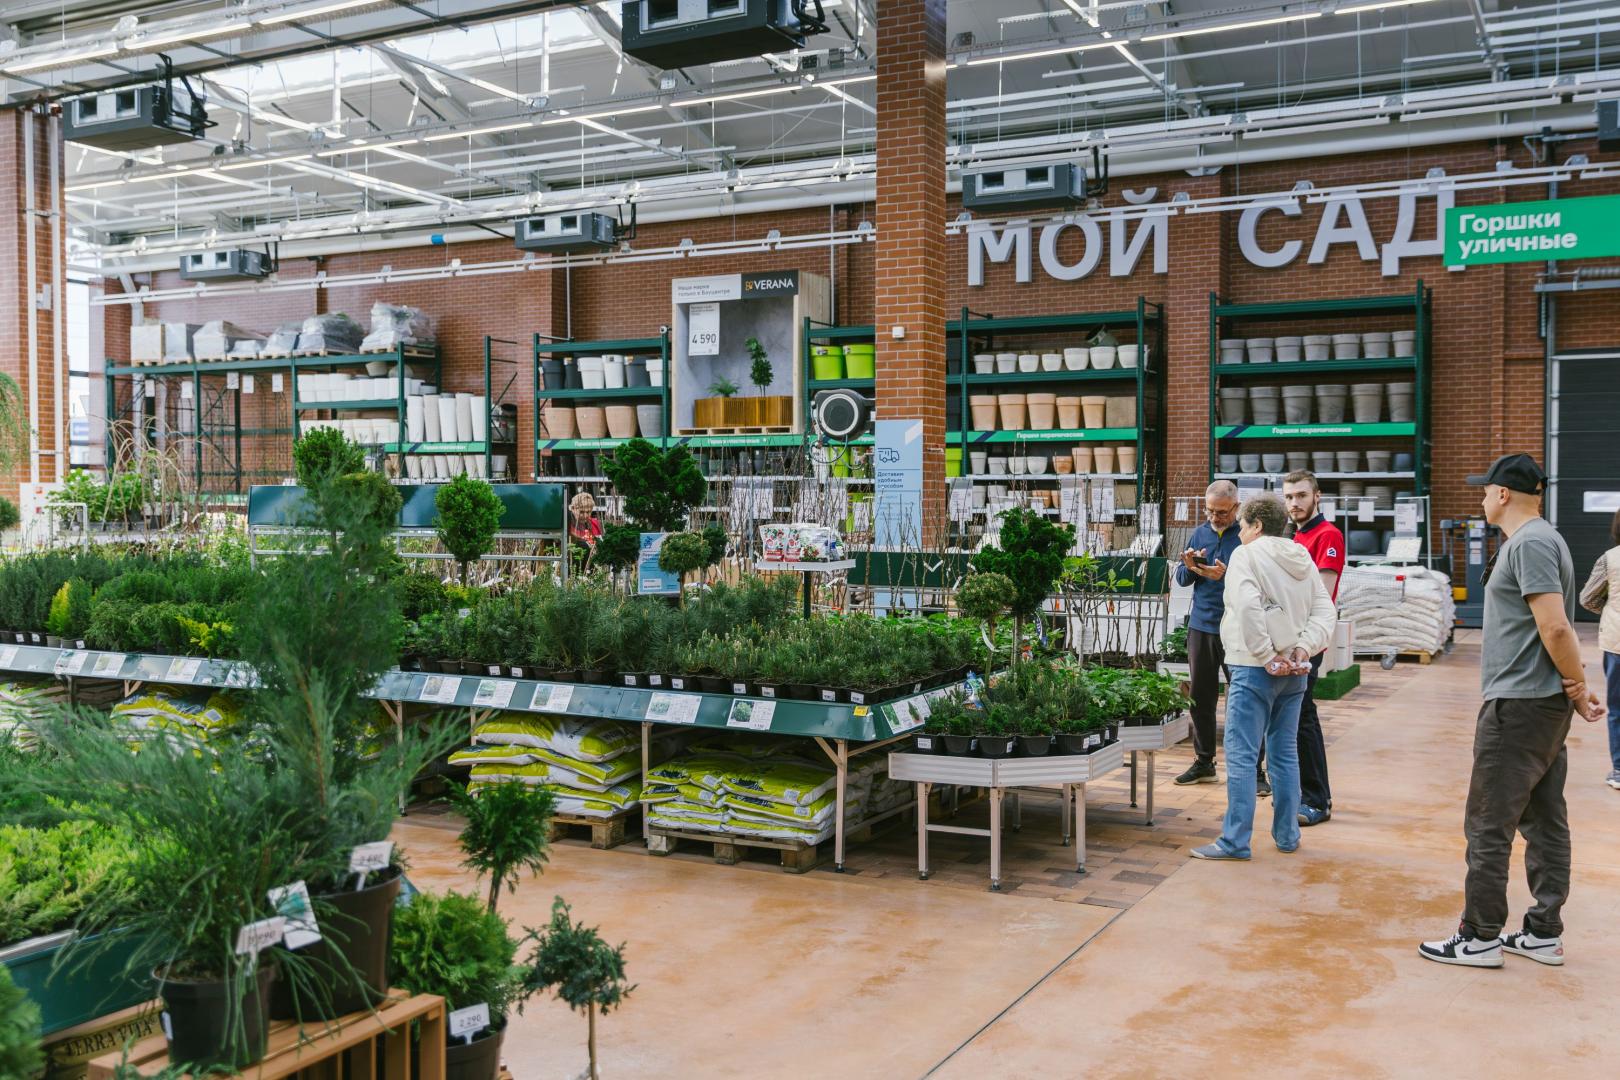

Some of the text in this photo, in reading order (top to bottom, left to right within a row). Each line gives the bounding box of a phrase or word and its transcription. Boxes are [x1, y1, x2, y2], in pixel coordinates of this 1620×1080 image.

[968, 184, 1465, 286] МОЙ САД
[1459, 212, 1561, 237] Горшки
[1458, 232, 1578, 260] уличные
[754, 278, 794, 291] VERANA
[692, 333, 717, 344] 4 590
[467, 1014, 482, 1025] 290
[66, 1031, 116, 1056] TERRA
